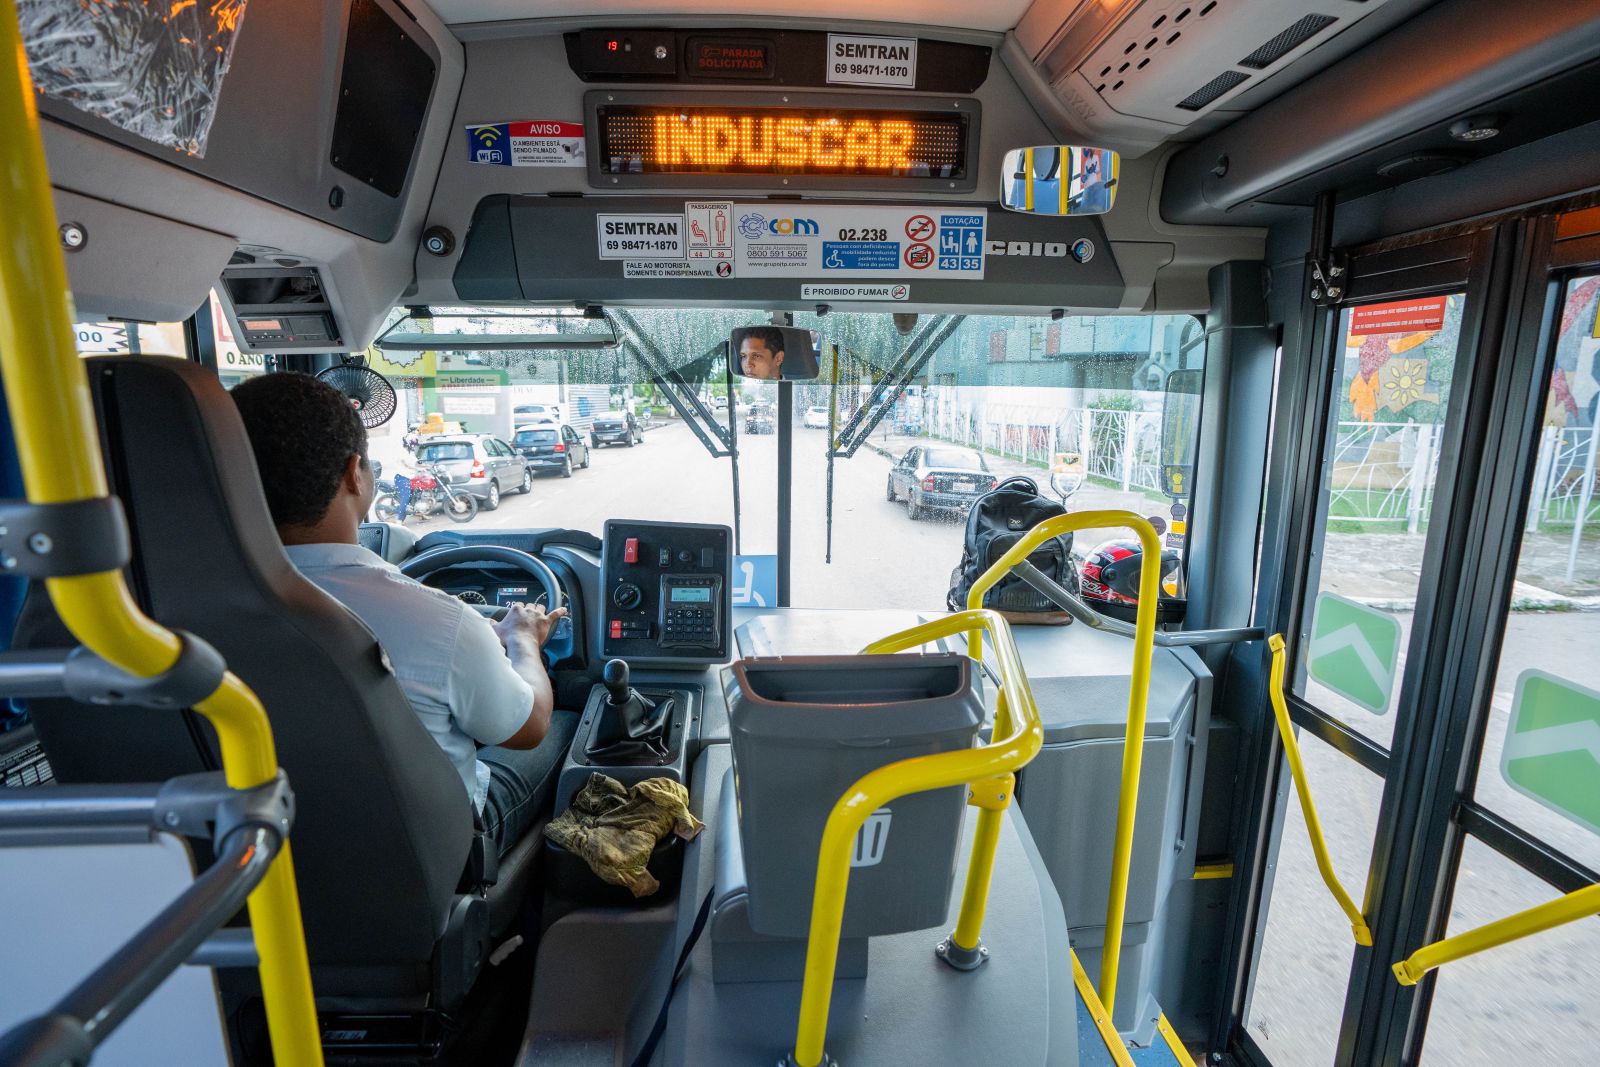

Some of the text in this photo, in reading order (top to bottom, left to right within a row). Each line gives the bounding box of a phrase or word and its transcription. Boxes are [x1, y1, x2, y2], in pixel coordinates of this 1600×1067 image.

[608, 41, 618, 50] 19
[722, 49, 763, 58] PARADA
[835, 42, 909, 61] SEMTRAN
[699, 58, 764, 69] SOLICITADA
[835, 63, 908, 77] 69 98471-1870
[530, 124, 561, 135] AVISO
[546, 139, 561, 147] ESTÁ
[655, 115, 913, 168] INDUSCAR
[944, 216, 980, 226] LOTAÇÃO
[605, 222, 678, 236] SEMTRAN
[838, 228, 887, 242] 02.238
[607, 240, 678, 251] 69 98471-1870
[986, 240, 1067, 257] CAIO
[941, 259, 958, 269] 43
[963, 259, 979, 270] 35
[664, 269, 714, 277] INDISPENSÁVEL
[804, 286, 889, 296] É PROIBIDO FUMAR
[450, 376, 485, 384] Liberdade
